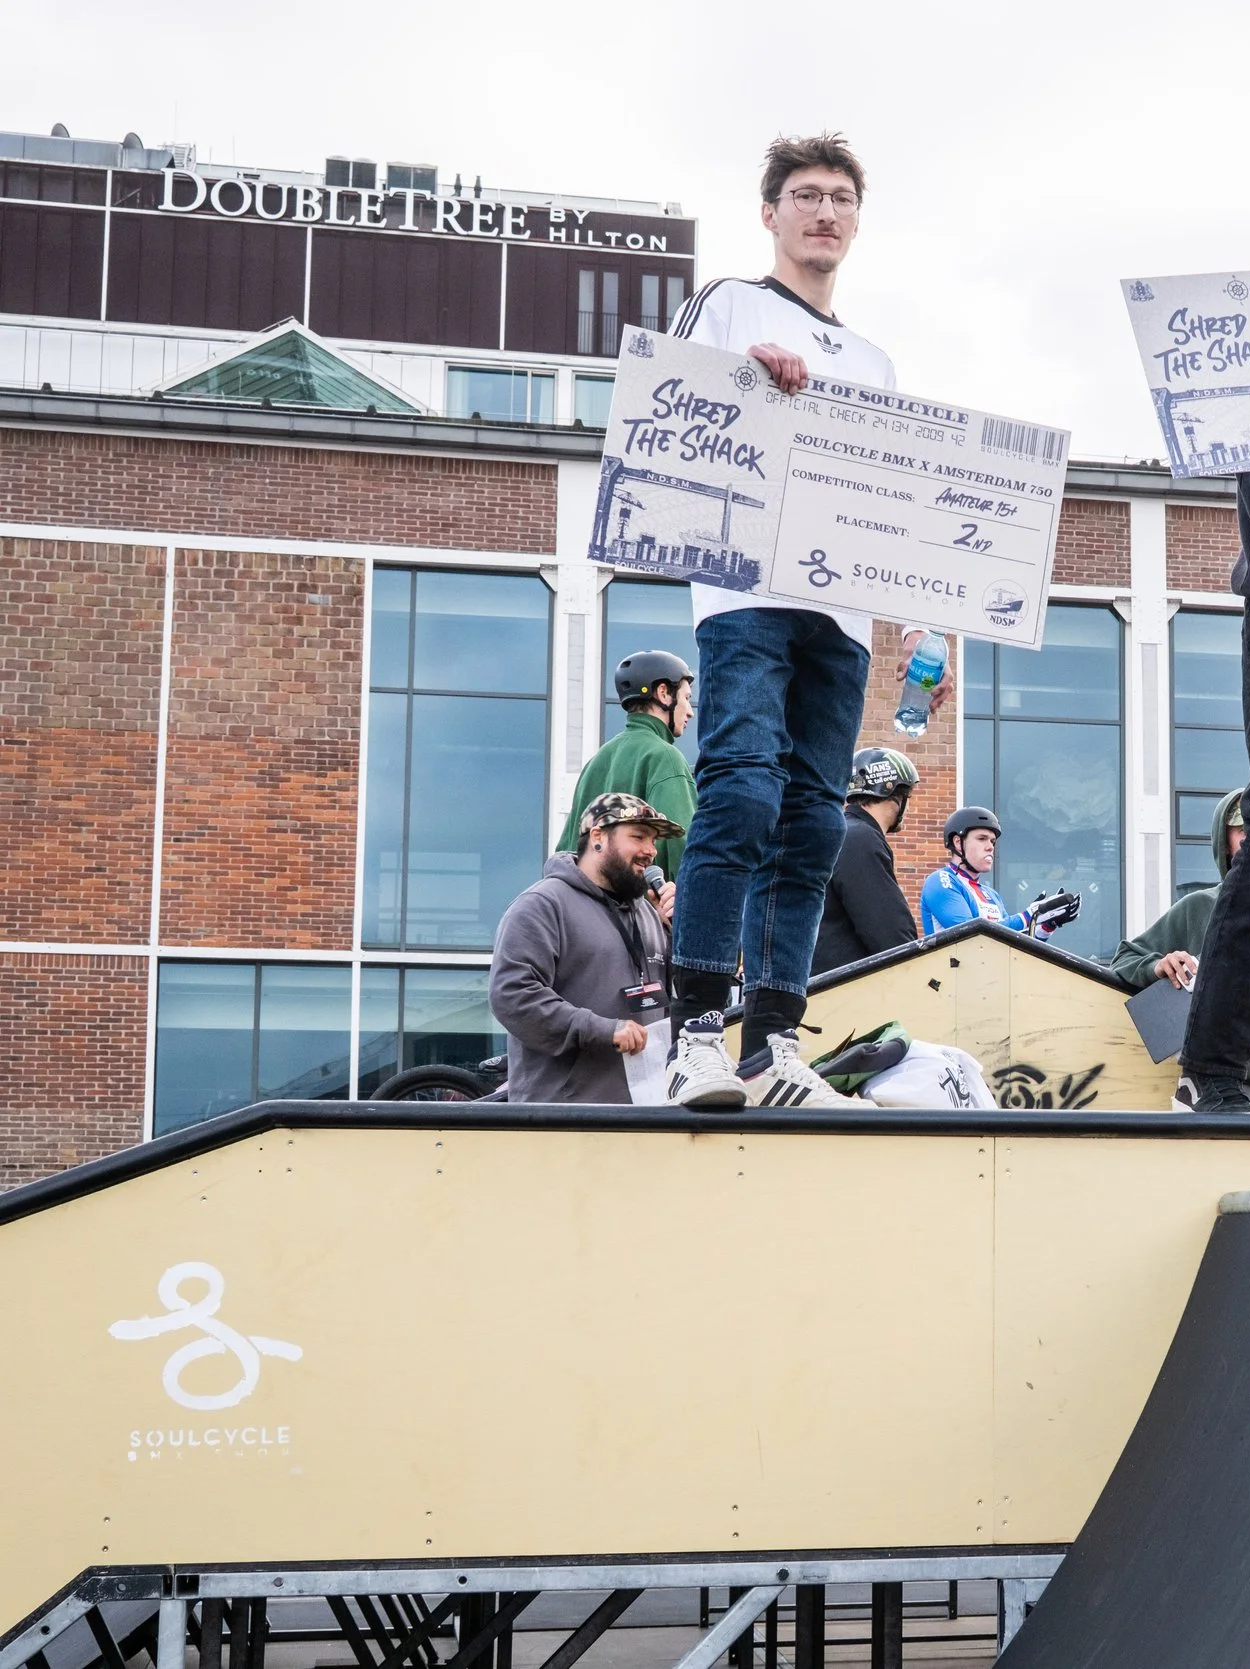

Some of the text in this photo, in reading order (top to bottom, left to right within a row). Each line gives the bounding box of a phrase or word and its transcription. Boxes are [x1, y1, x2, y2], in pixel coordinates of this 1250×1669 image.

[158, 168, 531, 239] DOUBLETREE
[550, 207, 591, 225] BY
[550, 227, 667, 252] HILTON
[1167, 307, 1247, 346] SHRED
[1152, 347, 1202, 383] THE
[651, 378, 742, 431] SHRED
[765, 391, 966, 447] OFFICIAL CHECK 24134 2009 42
[832, 384, 969, 425] OF SOULCYCLE
[622, 418, 766, 480] THE SHACK
[793, 433, 1053, 498] SOULCYCLE BMX X AMSTERDAM 750
[791, 468, 1018, 518] COMPETITION CLASS: AMATEUR 15+
[836, 514, 993, 553] PLACEMENT: 2ND
[852, 563, 967, 599] SOULCYCLE
[865, 760, 892, 774] VANS
[130, 1426, 290, 1447] SOULCYCLE
